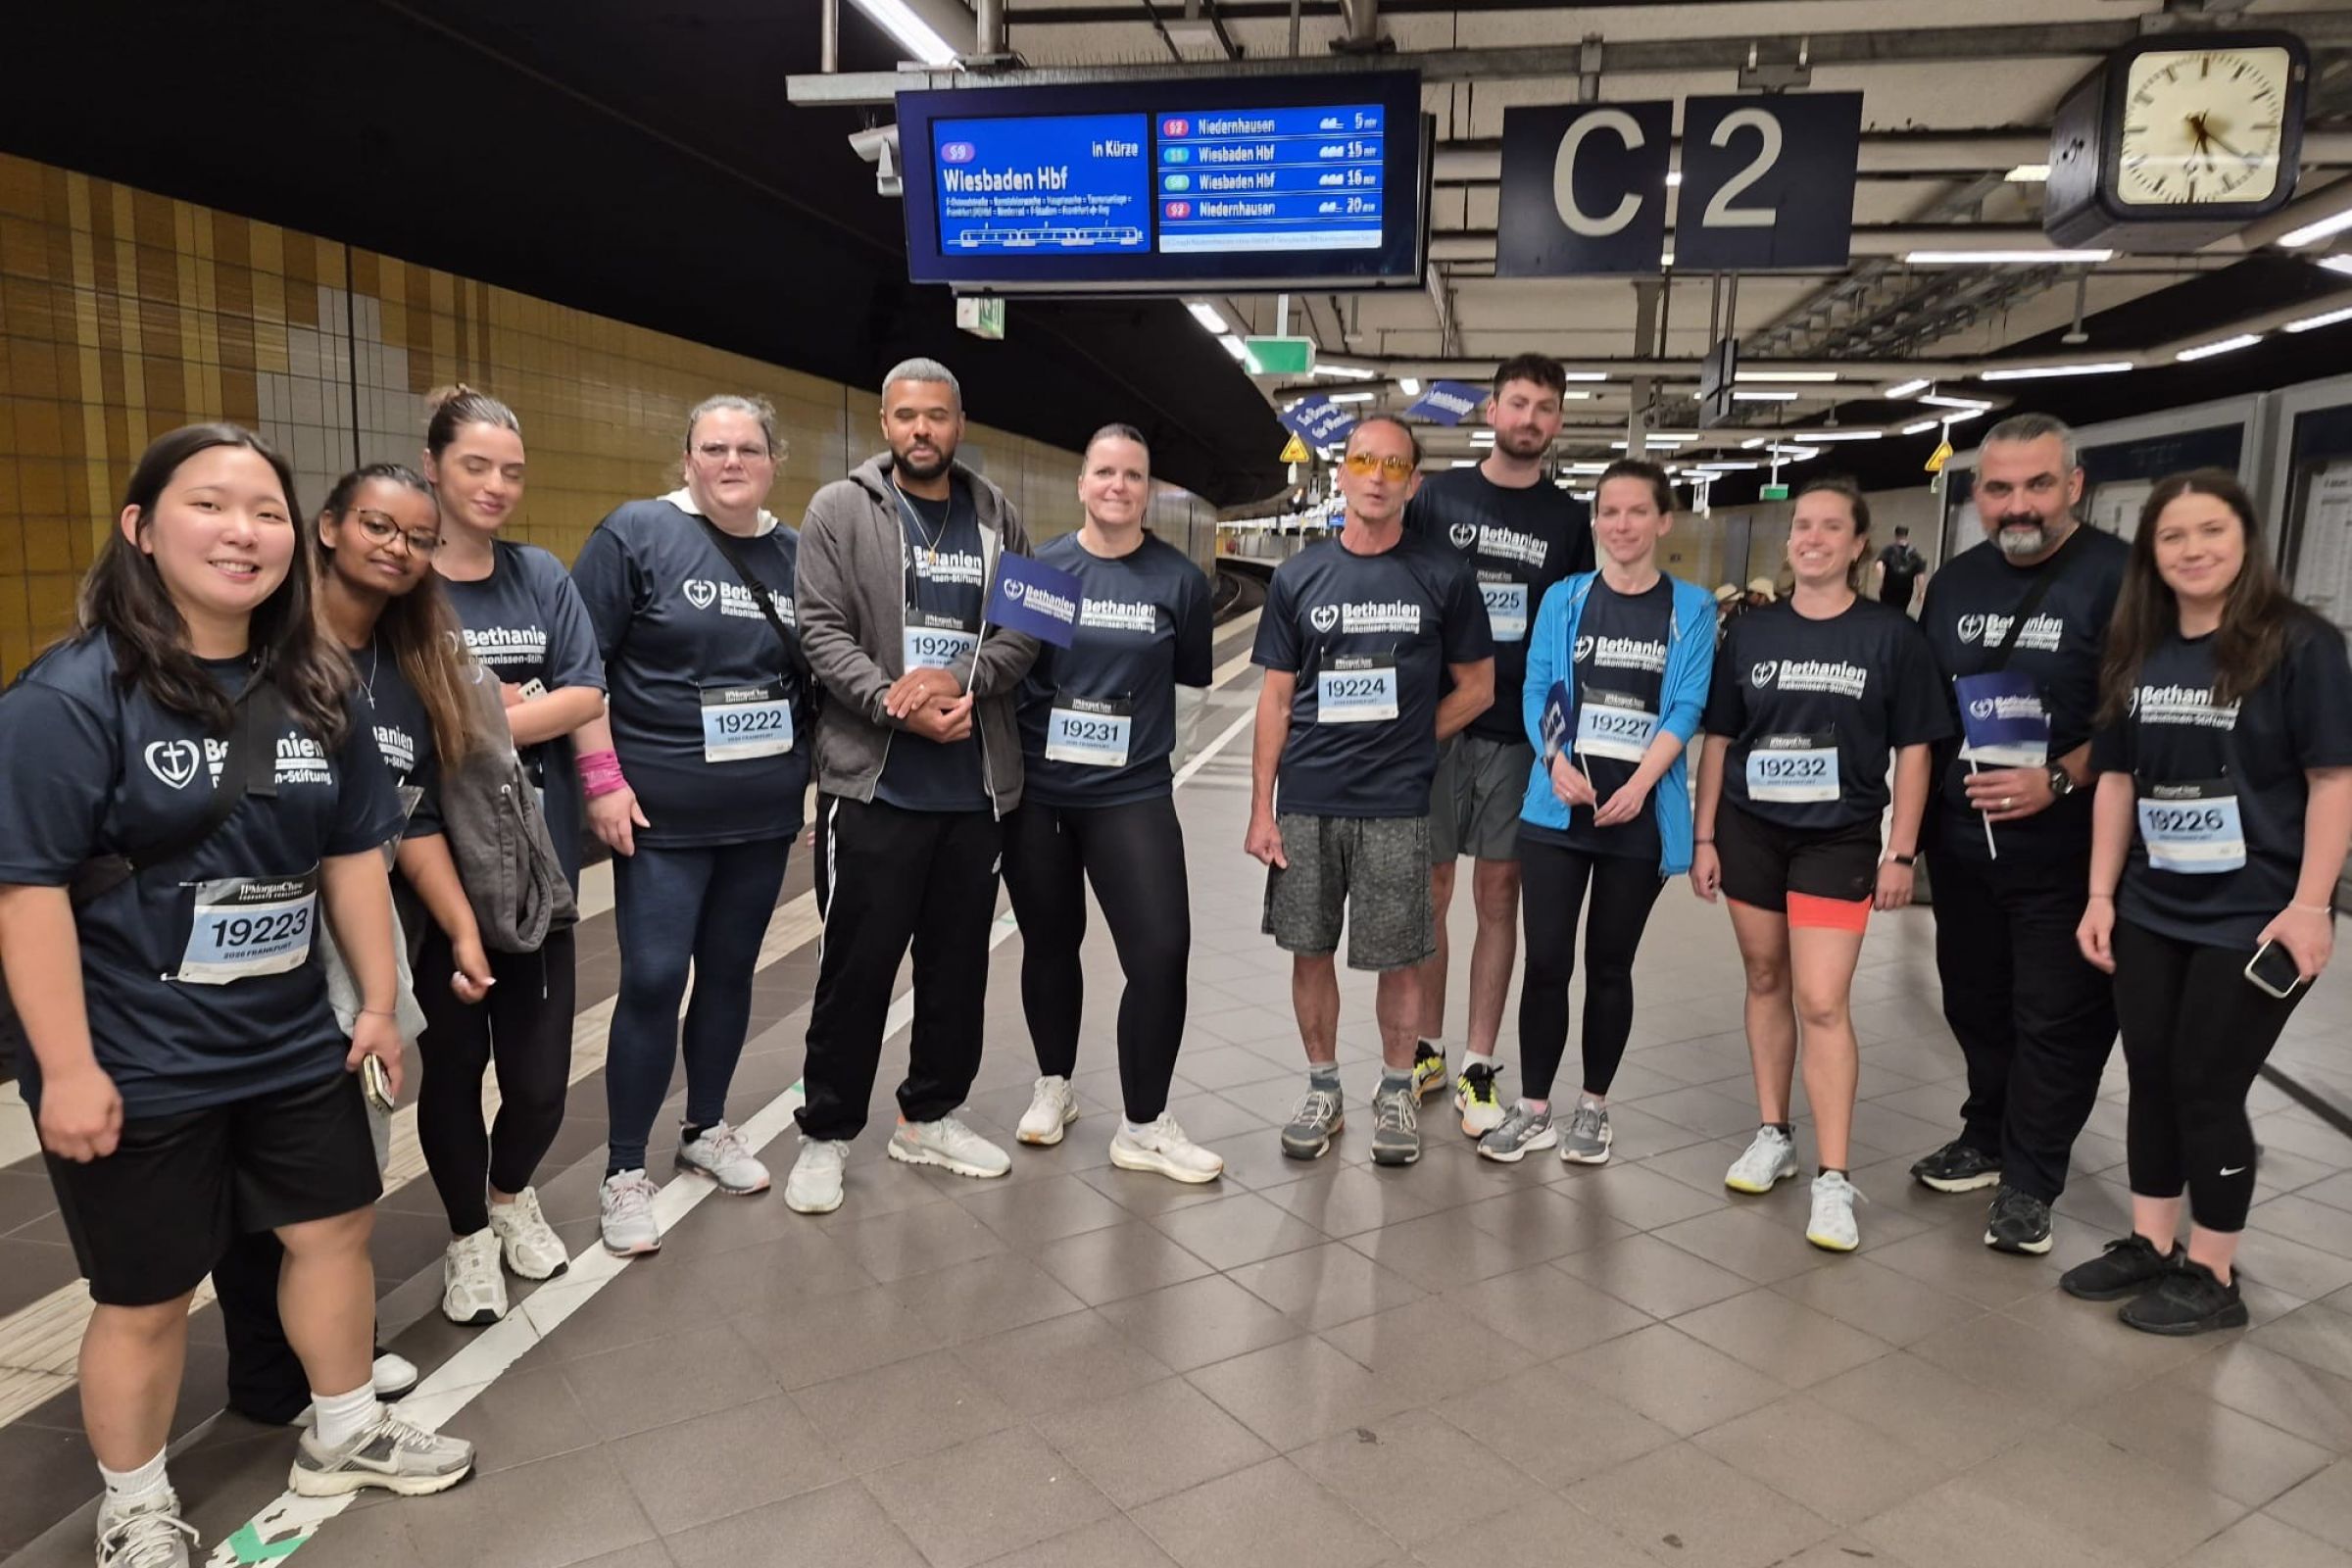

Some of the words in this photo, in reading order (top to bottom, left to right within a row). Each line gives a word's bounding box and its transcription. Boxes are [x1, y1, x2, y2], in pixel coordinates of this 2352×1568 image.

[1199, 118, 1275, 135] Niedernhausen
[950, 145, 966, 160] S9
[1092, 141, 1103, 158] in
[1105, 140, 1138, 158] Kürze
[1199, 145, 1253, 163] Wiesbaden
[1255, 144, 1275, 161] Hbf
[944, 168, 1034, 192] Wiesbaden
[1038, 166, 1068, 190] Hbf
[1552, 109, 1645, 236] C
[1702, 108, 1783, 228] 2
[1199, 172, 1253, 190] Wiesbaden
[1256, 172, 1276, 188] Hbf
[1200, 200, 1276, 218] Niedernhausen
[1348, 197, 1362, 213] 20
[1480, 524, 1548, 552] Bethanien
[1025, 584, 1076, 612] Bethanien
[1082, 597, 1156, 617] Bethanien
[1342, 599, 1420, 617] Bethanien
[1485, 591, 1520, 609] 225
[463, 624, 547, 647] Bethanie
[1596, 636, 1666, 659] Bethanie
[1781, 659, 1867, 683] Bethanien
[1327, 678, 1386, 698] 19224
[714, 710, 783, 734] 19222
[1060, 718, 1119, 742] 19231
[1590, 713, 1652, 739] 19227
[204, 731, 324, 762] Benien
[372, 725, 414, 753] anien
[1756, 757, 1827, 778] 19232
[2147, 808, 2224, 832] 19226
[212, 907, 309, 948] 19223
[246, 942, 292, 957] FRANKFURT
